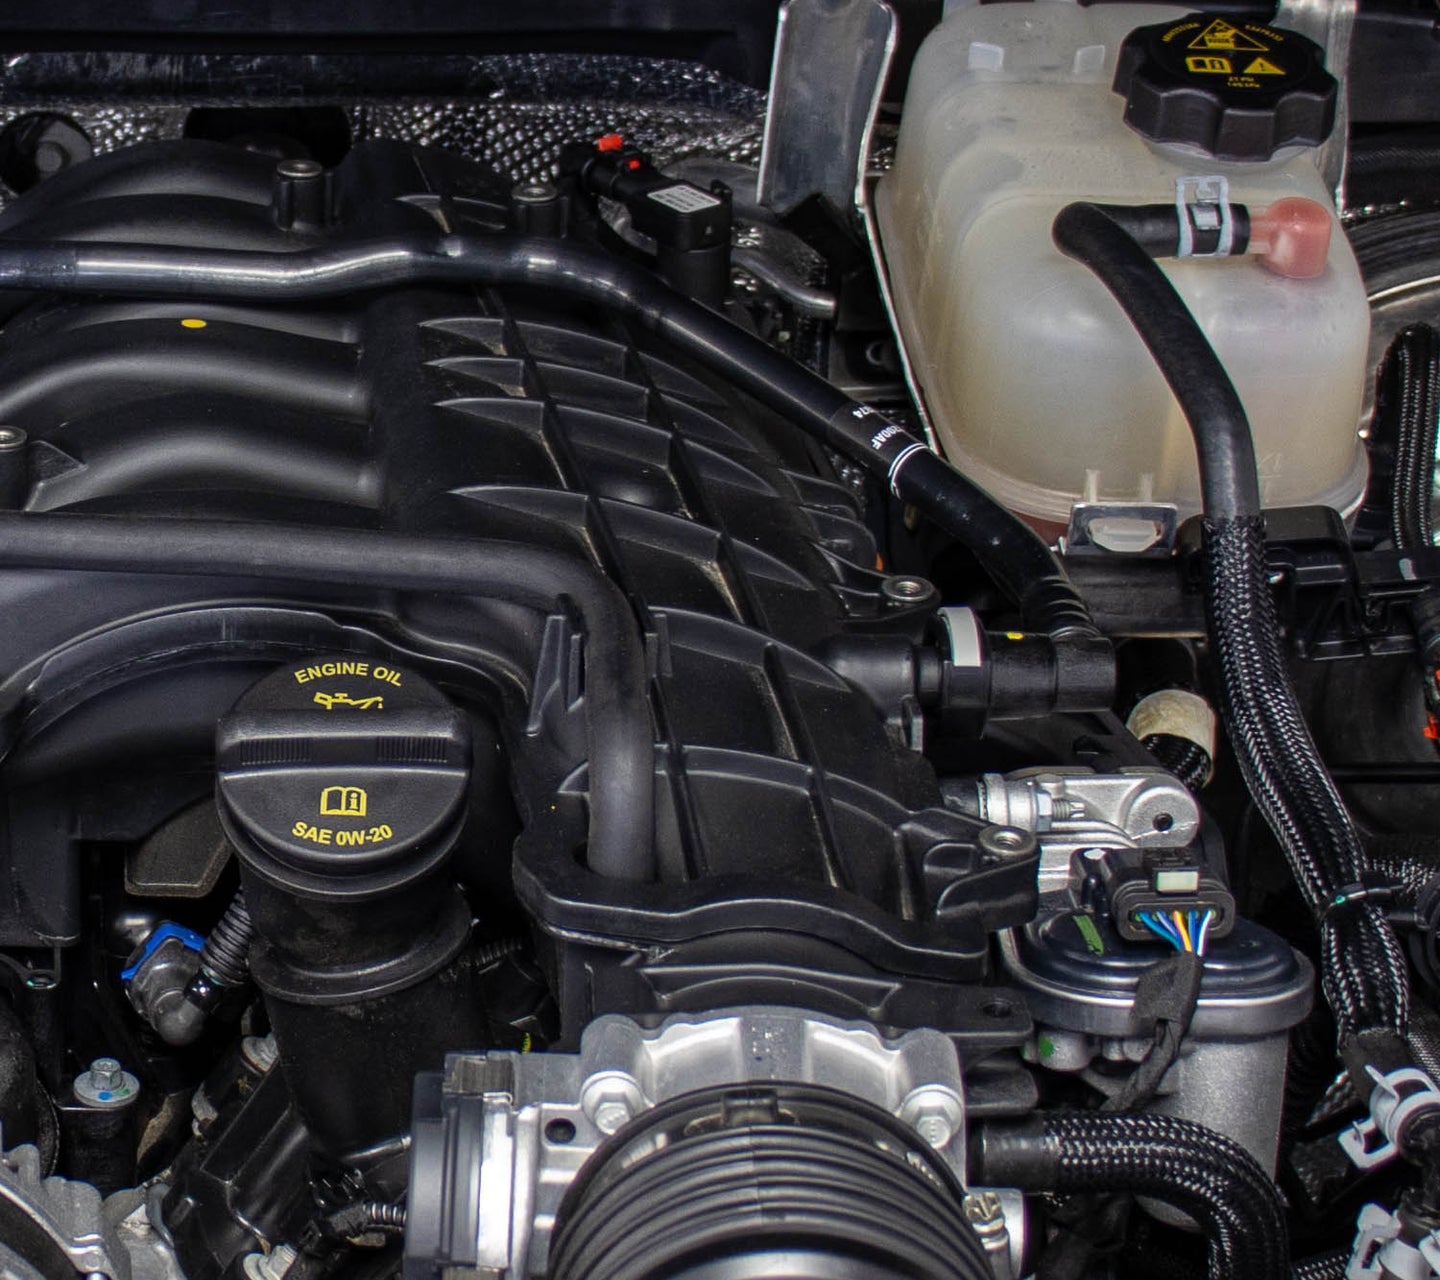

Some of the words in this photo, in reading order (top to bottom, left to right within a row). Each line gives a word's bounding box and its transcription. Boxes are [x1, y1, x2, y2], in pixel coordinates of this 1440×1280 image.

[294, 662, 369, 685] ENGINE
[373, 665, 402, 688] OIL
[292, 821, 331, 846] SAE
[335, 823, 393, 848] 0W-20
